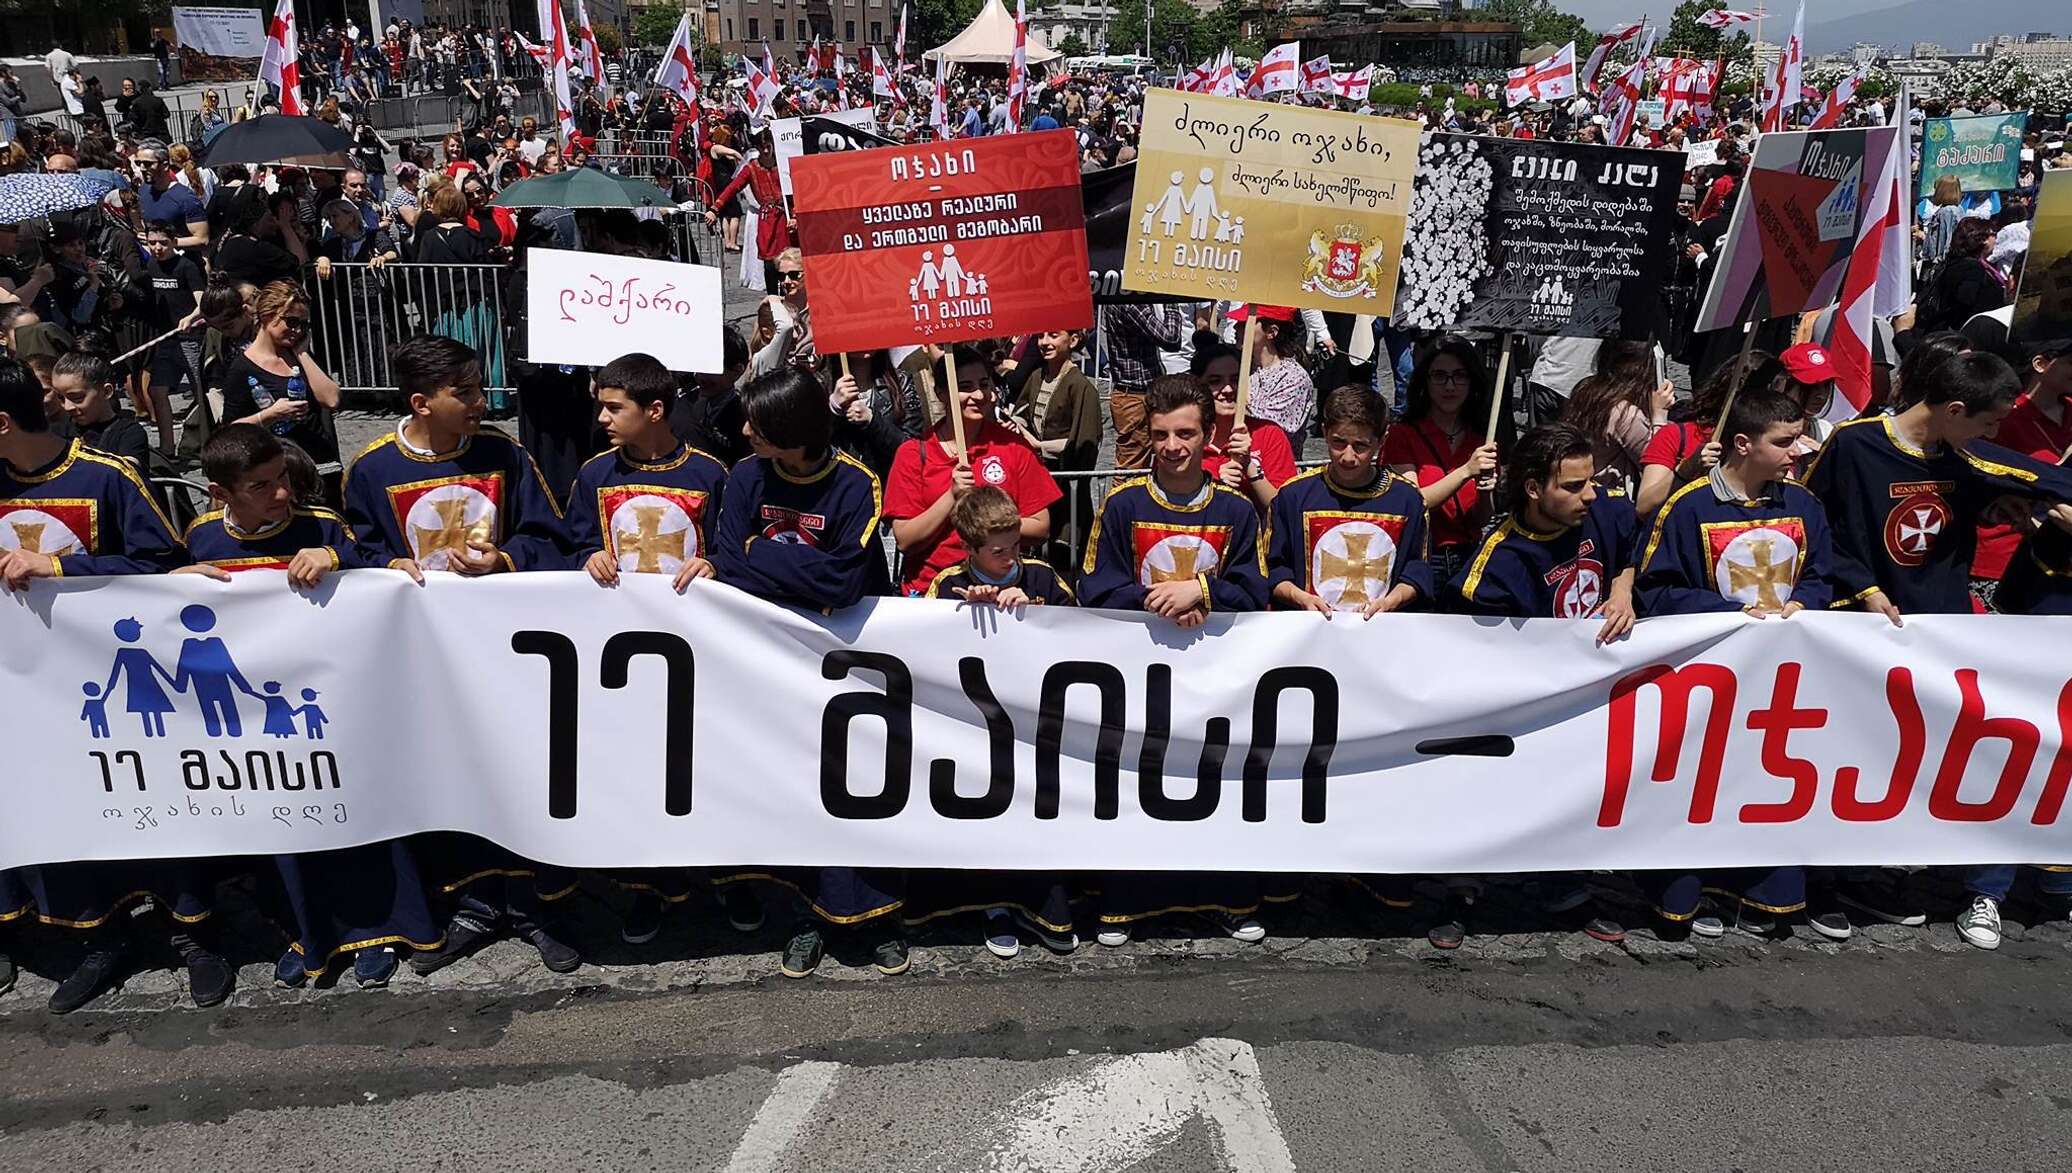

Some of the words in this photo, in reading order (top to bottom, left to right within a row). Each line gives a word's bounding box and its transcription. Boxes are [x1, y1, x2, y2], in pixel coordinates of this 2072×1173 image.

[1175, 103, 1280, 153] ძლიერი
[1292, 125, 1391, 164] ოჯახი,
[890, 150, 976, 181] ოჯახი
[1232, 163, 1289, 195] ძლიერი
[1294, 171, 1396, 208] სახელმწიფო!
[863, 202, 933, 224] ყველაზე
[942, 193, 1017, 216] რეალური
[1515, 189, 1590, 214] შემოქმედის
[1592, 197, 1653, 217] დიდებაში
[844, 234, 863, 250] და
[871, 225, 948, 247] ერთგული
[957, 215, 1042, 239] მეგობარი
[1138, 238, 1160, 263] 17
[1174, 243, 1241, 272] მაისი
[1506, 261, 1521, 275] და
[911, 303, 930, 321] 17
[939, 297, 992, 319] მაისი
[511, 630, 695, 819] 17
[820, 649, 1339, 824] მაისი
[88, 749, 147, 792] 17
[180, 749, 341, 791] მაისი
[102, 795, 247, 830] ოჯახის
[272, 803, 348, 828] დღე
